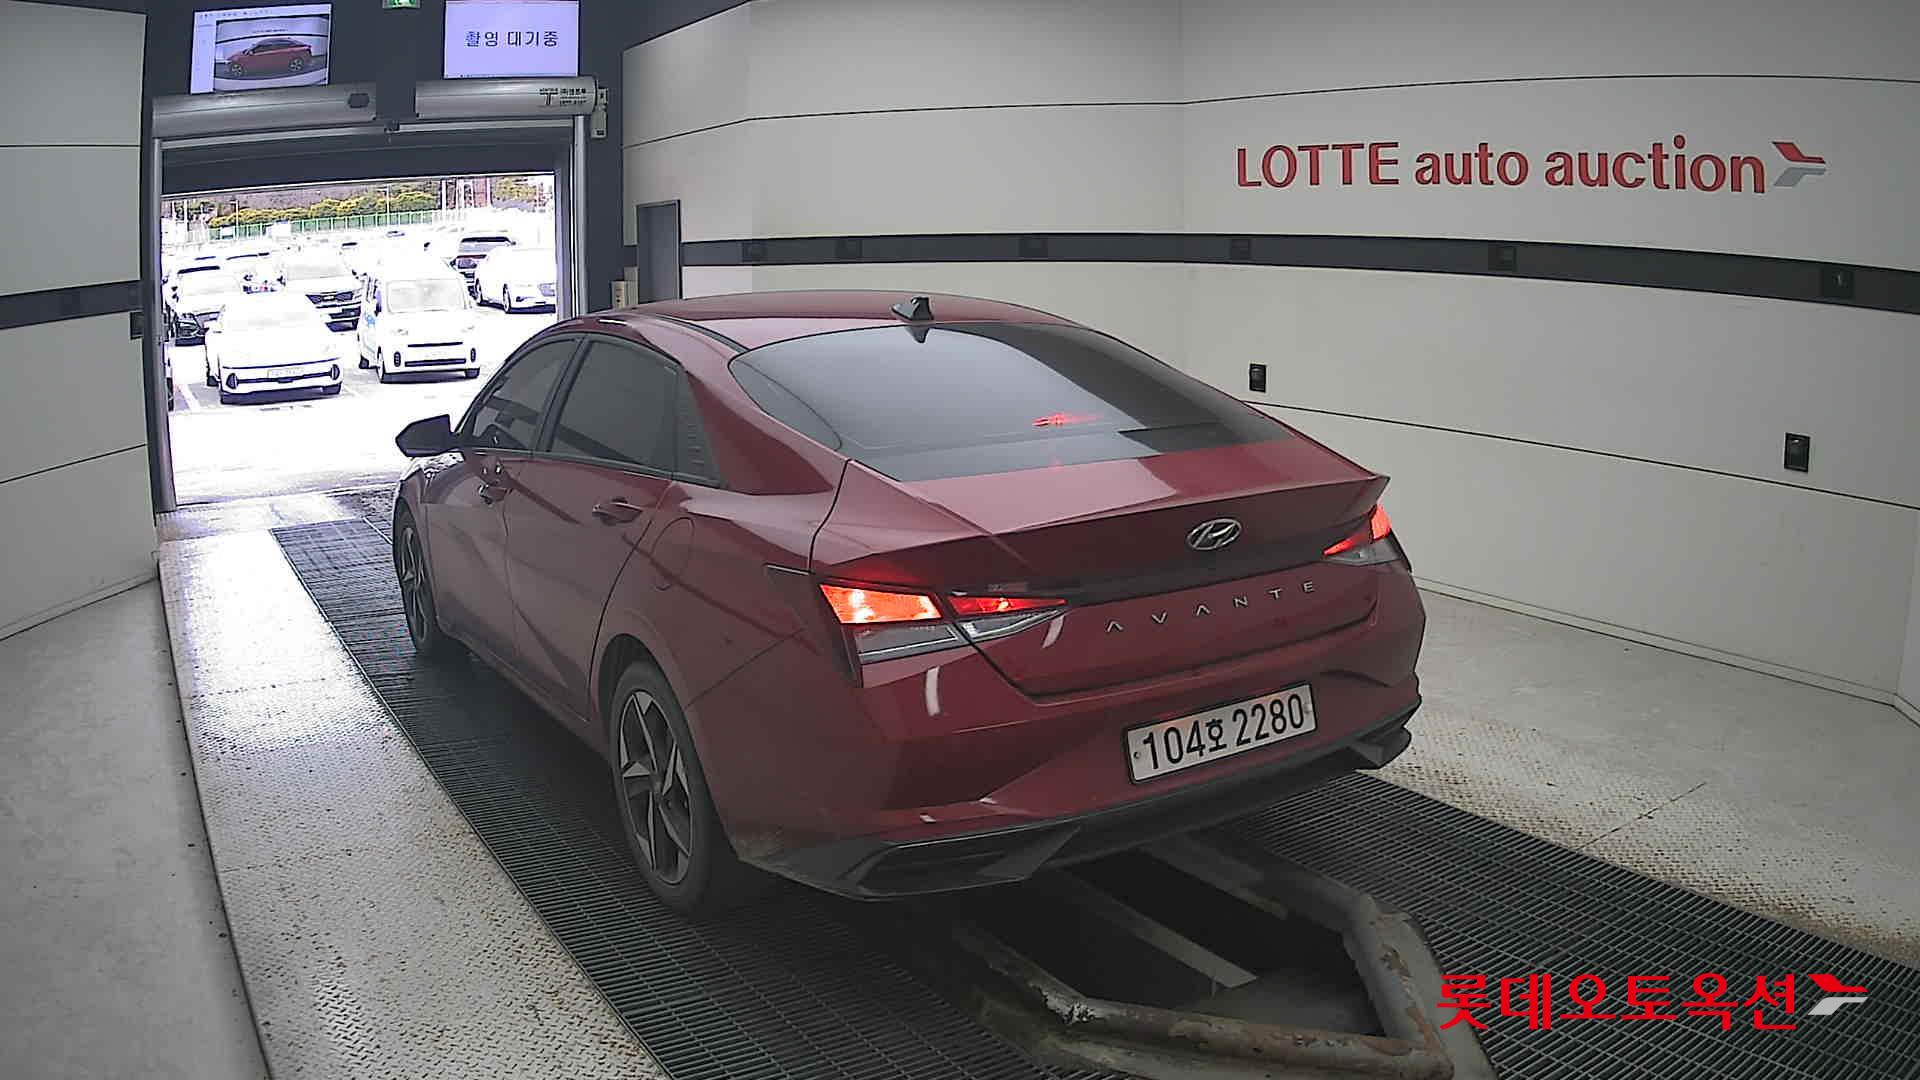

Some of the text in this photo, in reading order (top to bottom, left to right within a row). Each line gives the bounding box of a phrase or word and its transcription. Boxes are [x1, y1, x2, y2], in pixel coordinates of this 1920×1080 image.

[508, 30, 559, 48] 대기중
[1237, 135, 1765, 194] LOTTE auto auction
[1106, 581, 1316, 633] AVANTE
[1142, 693, 1306, 770] 104호 2280
